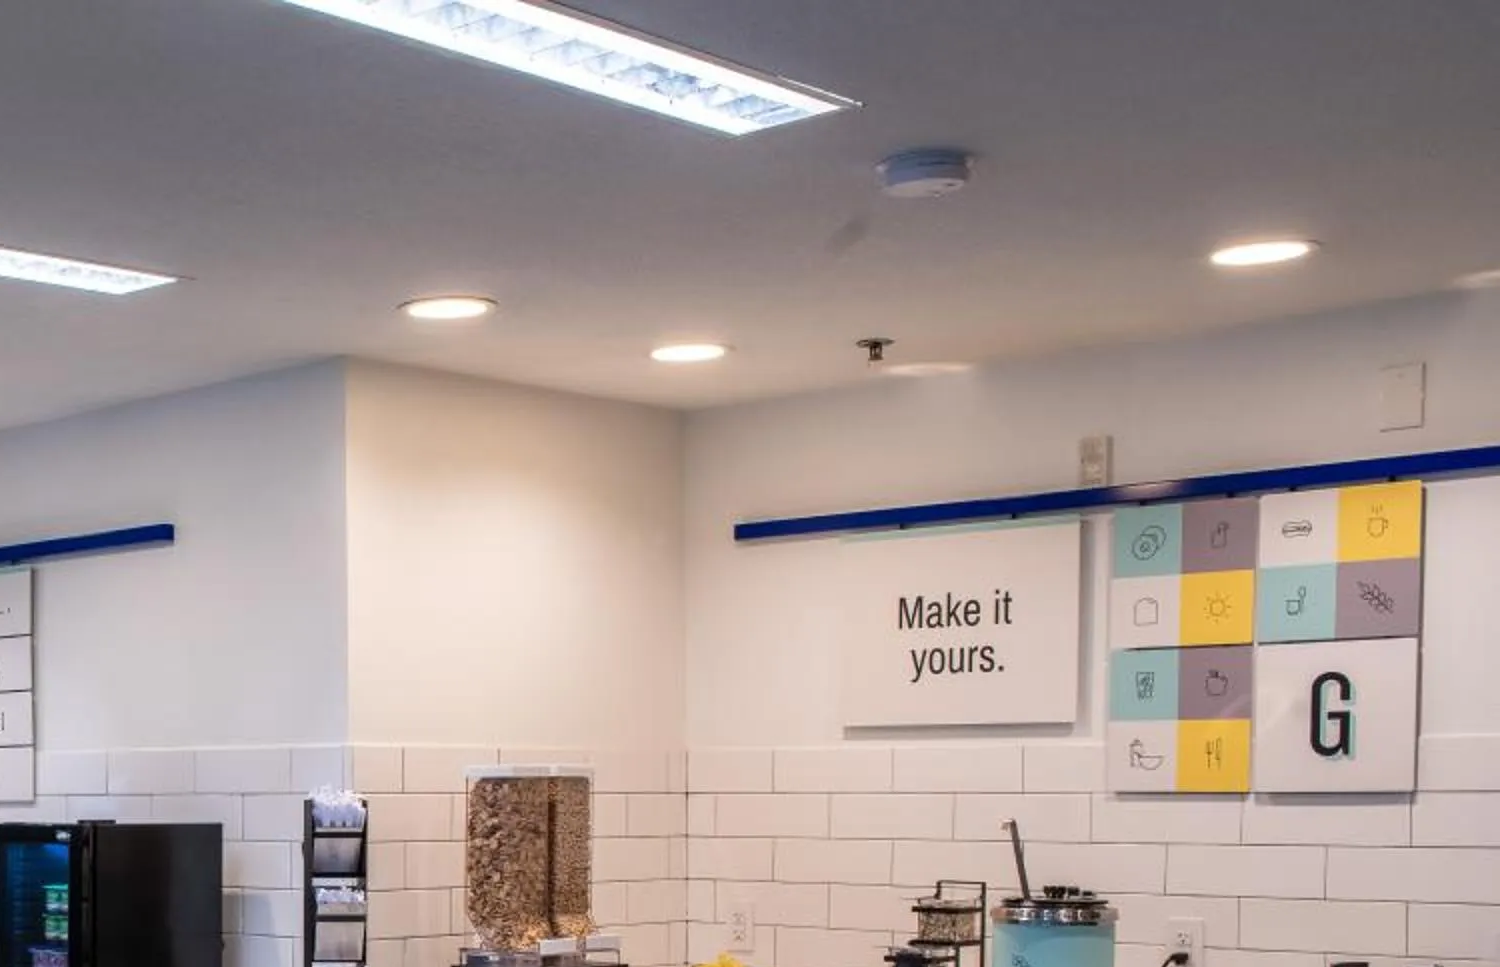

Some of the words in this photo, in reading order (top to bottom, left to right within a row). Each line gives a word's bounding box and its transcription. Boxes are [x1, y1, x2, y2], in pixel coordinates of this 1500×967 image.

[898, 591, 982, 630] Make
[994, 588, 1013, 625] it
[909, 644, 1005, 684] yours.
[1310, 671, 1356, 760] G
